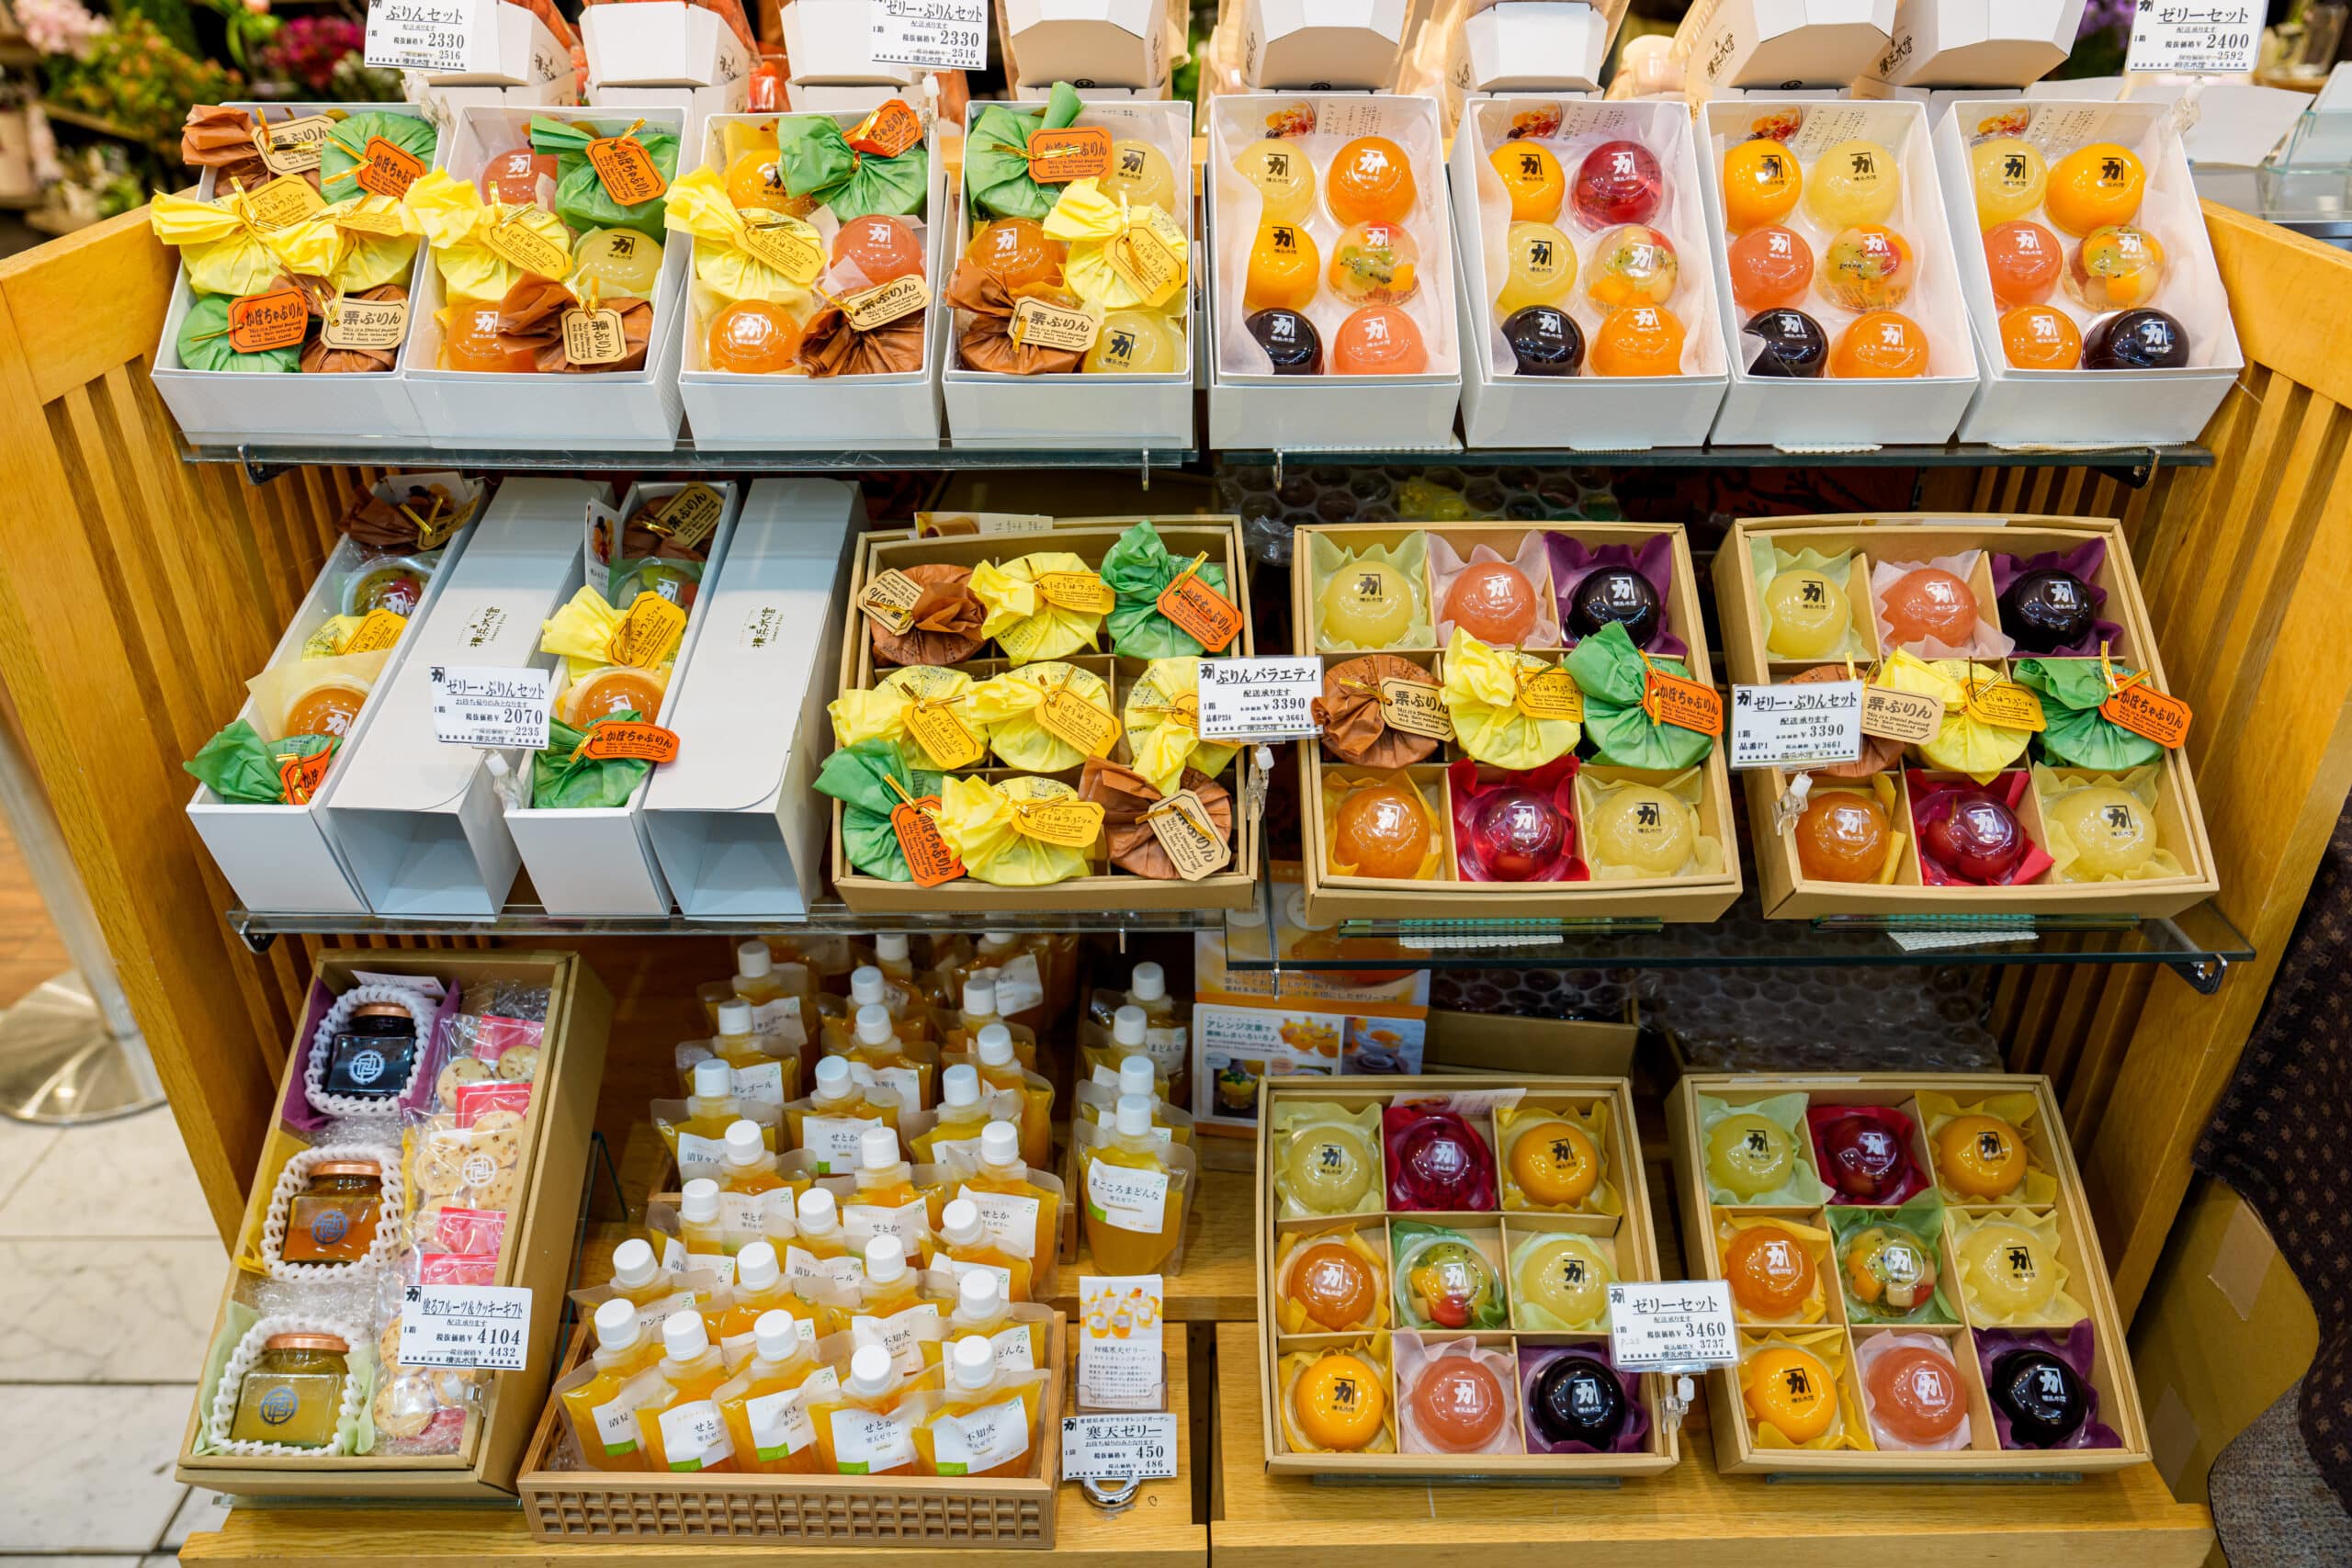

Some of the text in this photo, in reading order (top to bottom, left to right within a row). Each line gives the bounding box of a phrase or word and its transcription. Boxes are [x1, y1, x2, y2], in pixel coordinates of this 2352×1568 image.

[386, 6, 463, 23] ぷりんセット
[887, 0, 982, 22] ゼリー・ぷりんセット
[2159, 7, 2248, 23] ゼリーセット
[428, 33, 464, 49] 2330
[940, 29, 979, 47] 2330
[2206, 34, 2249, 49] 2400
[439, 50, 461, 60] 2516
[952, 49, 976, 58] 2516
[2217, 51, 2244, 61] 2592
[246, 301, 303, 328] かぼちゃぷりん
[343, 310, 401, 326] 栗ぷりん
[1030, 310, 1090, 333] 栗ぷりん
[667, 491, 707, 529] 栗ぷりん
[1216, 668, 1316, 683] ぷりんバラエティ
[447, 680, 544, 698] ゼリー・ぷりんセット
[1660, 683, 1718, 716] かぼちゃぷりん
[1754, 692, 1857, 710] ゼリー・ぷりんセット
[1868, 696, 1932, 719] 栗ぷりん
[504, 708, 543, 725] 2070
[2120, 690, 2183, 729] かぼちゃぷりん
[515, 727, 539, 736] 2235
[606, 730, 673, 749] かぼちゃぷりん
[831, 1134, 858, 1143] せとか
[1091, 1178, 1160, 1201] まごころまどんな
[981, 1210, 1011, 1220] せとか
[872, 1224, 901, 1234] せとか
[1633, 1295, 1718, 1313] ゼリーセット
[478, 1328, 520, 1345] 4104
[1686, 1323, 1725, 1337] 3460
[883, 1330, 910, 1347] 不知火
[1700, 1339, 1724, 1348] 3737
[489, 1347, 515, 1357] 4432
[865, 1420, 895, 1434] せとか
[964, 1424, 995, 1441] 不知火
[1086, 1425, 1162, 1438] 寒天ゼリー
[1136, 1446, 1164, 1459] 450
[1146, 1460, 1163, 1468] 486
